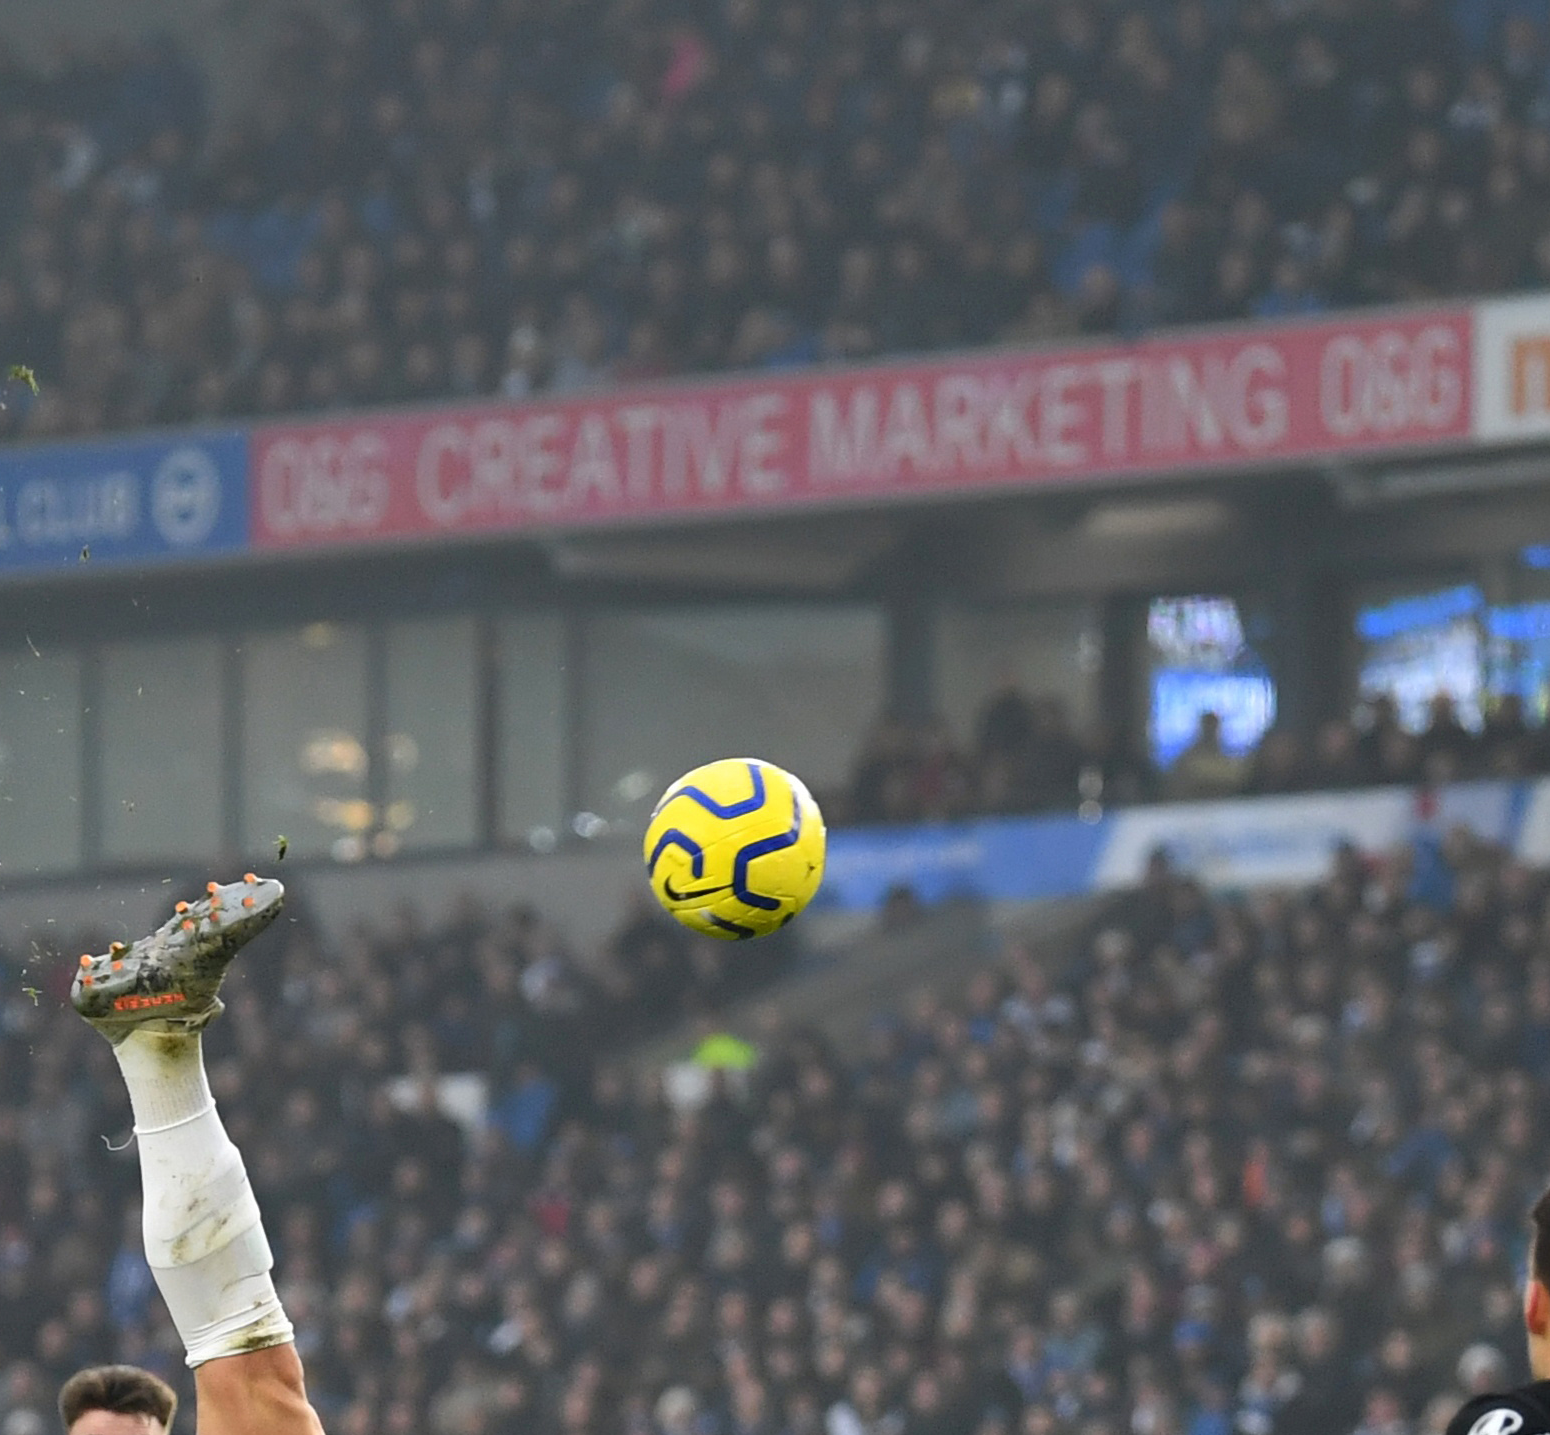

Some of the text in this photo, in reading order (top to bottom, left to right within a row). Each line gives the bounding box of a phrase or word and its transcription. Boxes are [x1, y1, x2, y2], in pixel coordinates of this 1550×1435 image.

[415, 393, 787, 524] CREATIVE
[806, 343, 1290, 482] MARKETING
[16, 470, 141, 546] CLUB
